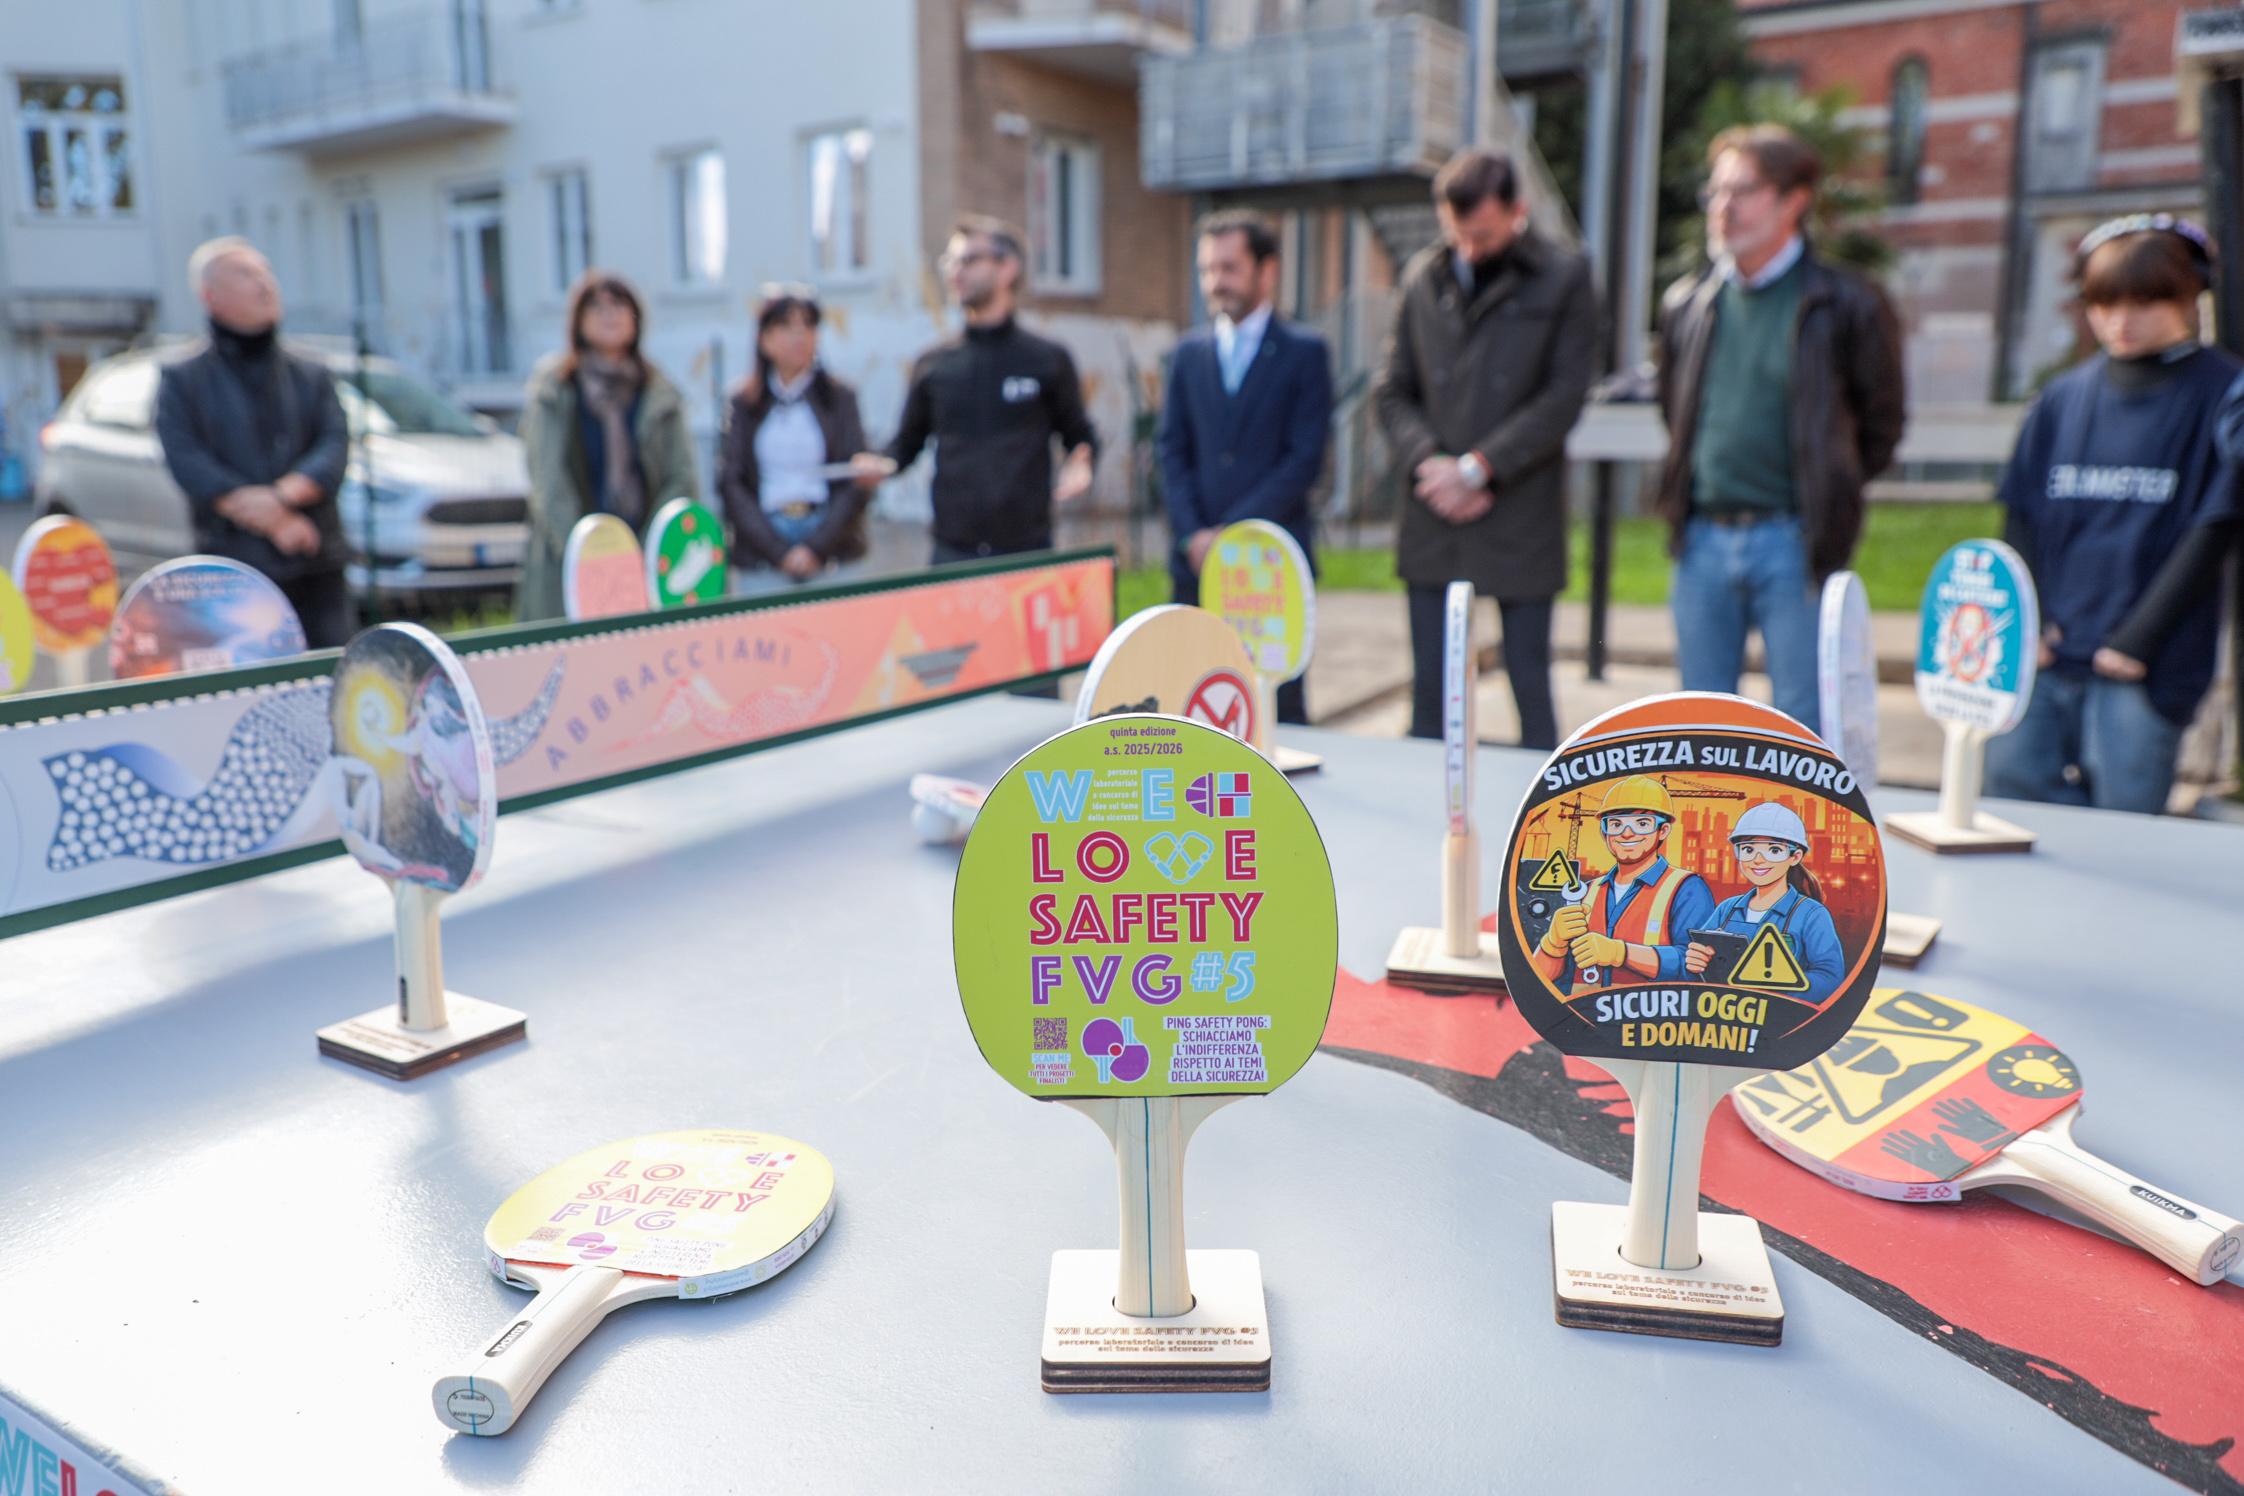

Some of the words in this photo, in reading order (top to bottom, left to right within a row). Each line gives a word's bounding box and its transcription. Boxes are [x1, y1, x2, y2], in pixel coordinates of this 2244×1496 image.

[544, 640, 792, 771] ABBRACCIAMI
[1110, 727, 1137, 738] quinta
[1140, 726, 1176, 736] edizione
[1104, 745, 1121, 756] a.s.
[1124, 743, 1183, 755] 2025/2026
[1543, 740, 1694, 791] SICUREZZA
[1700, 745, 1740, 768] SUL
[1745, 745, 1856, 795] LAVORO
[1029, 892, 1264, 945] SAFETY
[1031, 953, 1182, 1006] FVG
[1190, 951, 1256, 1003] #5
[1595, 990, 1689, 1022] SICURI
[1697, 992, 1768, 1026] OGGI
[1167, 1017, 1191, 1028] PING
[1194, 1017, 1233, 1028] SAFETY
[1236, 1016, 1268, 1028] PONG:
[1176, 1043, 1258, 1055] L'INDIFFERENZA
[1183, 1030, 1252, 1042] SCHIACCIAMO
[1621, 1023, 1635, 1047] E
[1640, 1022, 1759, 1054] DOMANI!
[1173, 1057, 1221, 1069] RISPETTO
[1224, 1057, 1234, 1068] AI
[1238, 1056, 1262, 1068] TEMI
[1171, 1071, 1203, 1082] DELLA
[1206, 1070, 1264, 1082] SICUREZZA!
[576, 1181, 771, 1213] SAFETY
[2138, 1190, 2186, 1216] KUIKMA
[549, 1202, 677, 1231] FVG
[1055, 1327, 1081, 1335] WE
[1085, 1327, 1129, 1335] LOVE
[1133, 1327, 1196, 1335] SAFETY
[1200, 1327, 1236, 1335] FVG
